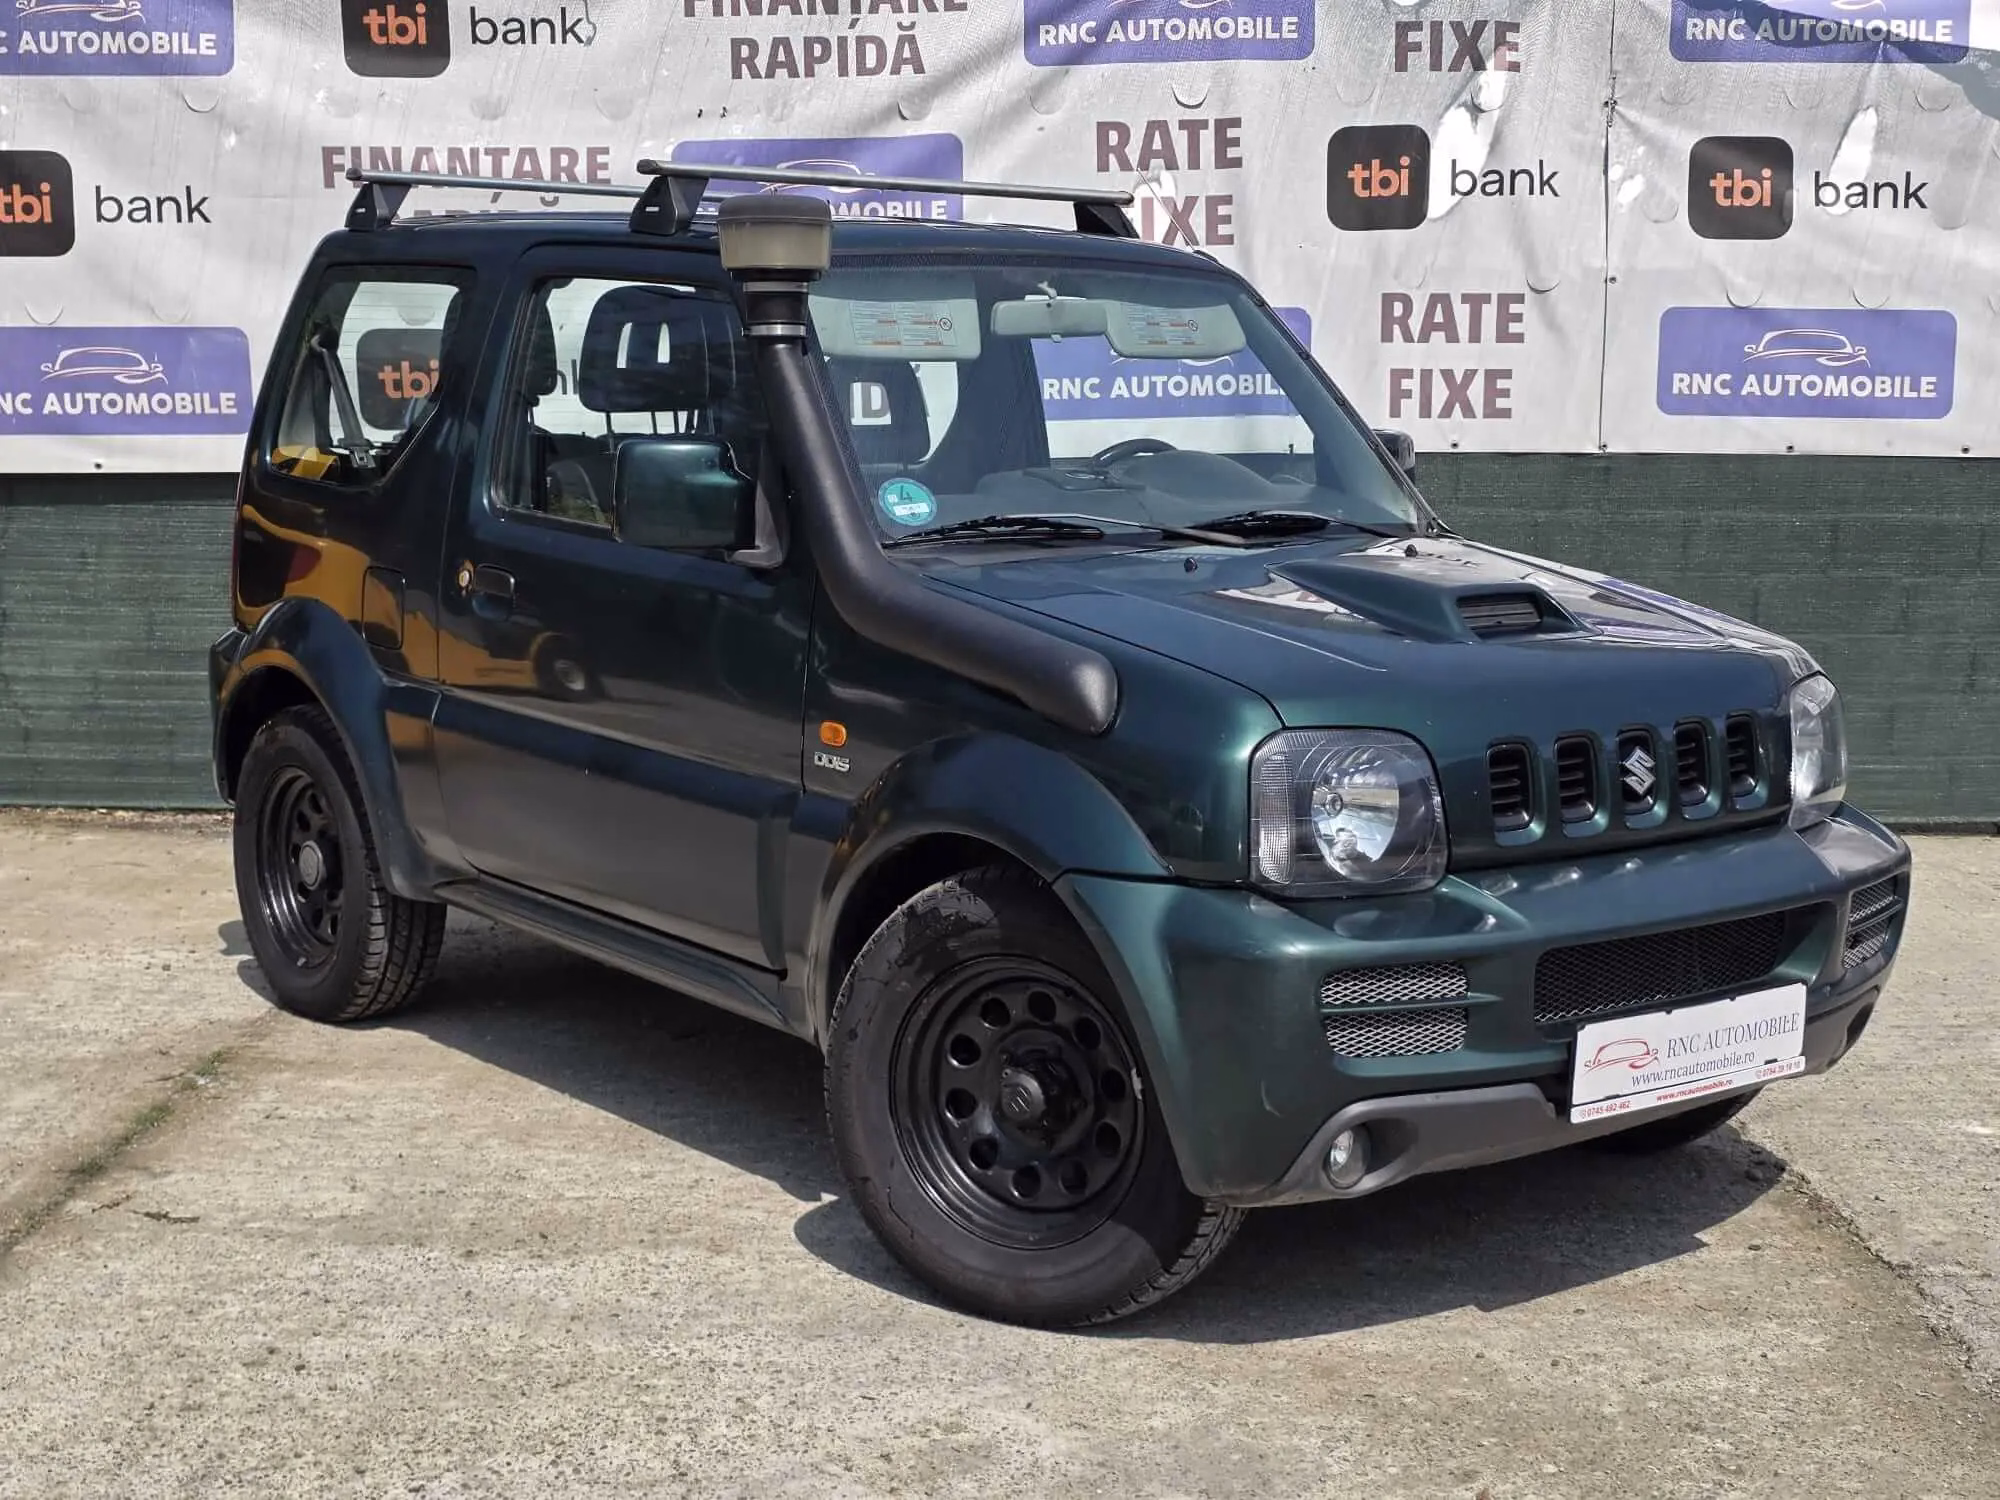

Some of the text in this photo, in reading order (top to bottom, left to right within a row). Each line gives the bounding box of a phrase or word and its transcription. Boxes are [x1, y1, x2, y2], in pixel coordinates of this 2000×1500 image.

[363, 2, 585, 45] tbi bank
[1039, 16, 1299, 46] RNC AUTOMOBILE
[1686, 17, 1954, 42] RNC AUTOMOBILE
[18, 31, 217, 55] AUTOMOBILE
[1394, 20, 1520, 72] FIXE
[1096, 117, 1243, 172] RATE
[1347, 156, 1561, 198] tbi bank
[1709, 168, 1929, 209] tbi bank
[95, 185, 212, 223] bank
[1140, 195, 1235, 246] IXE
[1380, 293, 1526, 343] RATE
[0, 392, 238, 415] NC AUTOMOBILE
[1043, 373, 1286, 400] RNC AUTOMOBIL
[1389, 368, 1513, 419] FIXE
[1671, 372, 1938, 398] RNC AUTOMOBILE
[1666, 1032, 1702, 1059] RNC
[1631, 1051, 1755, 1088] www.rncautomobile.ro
